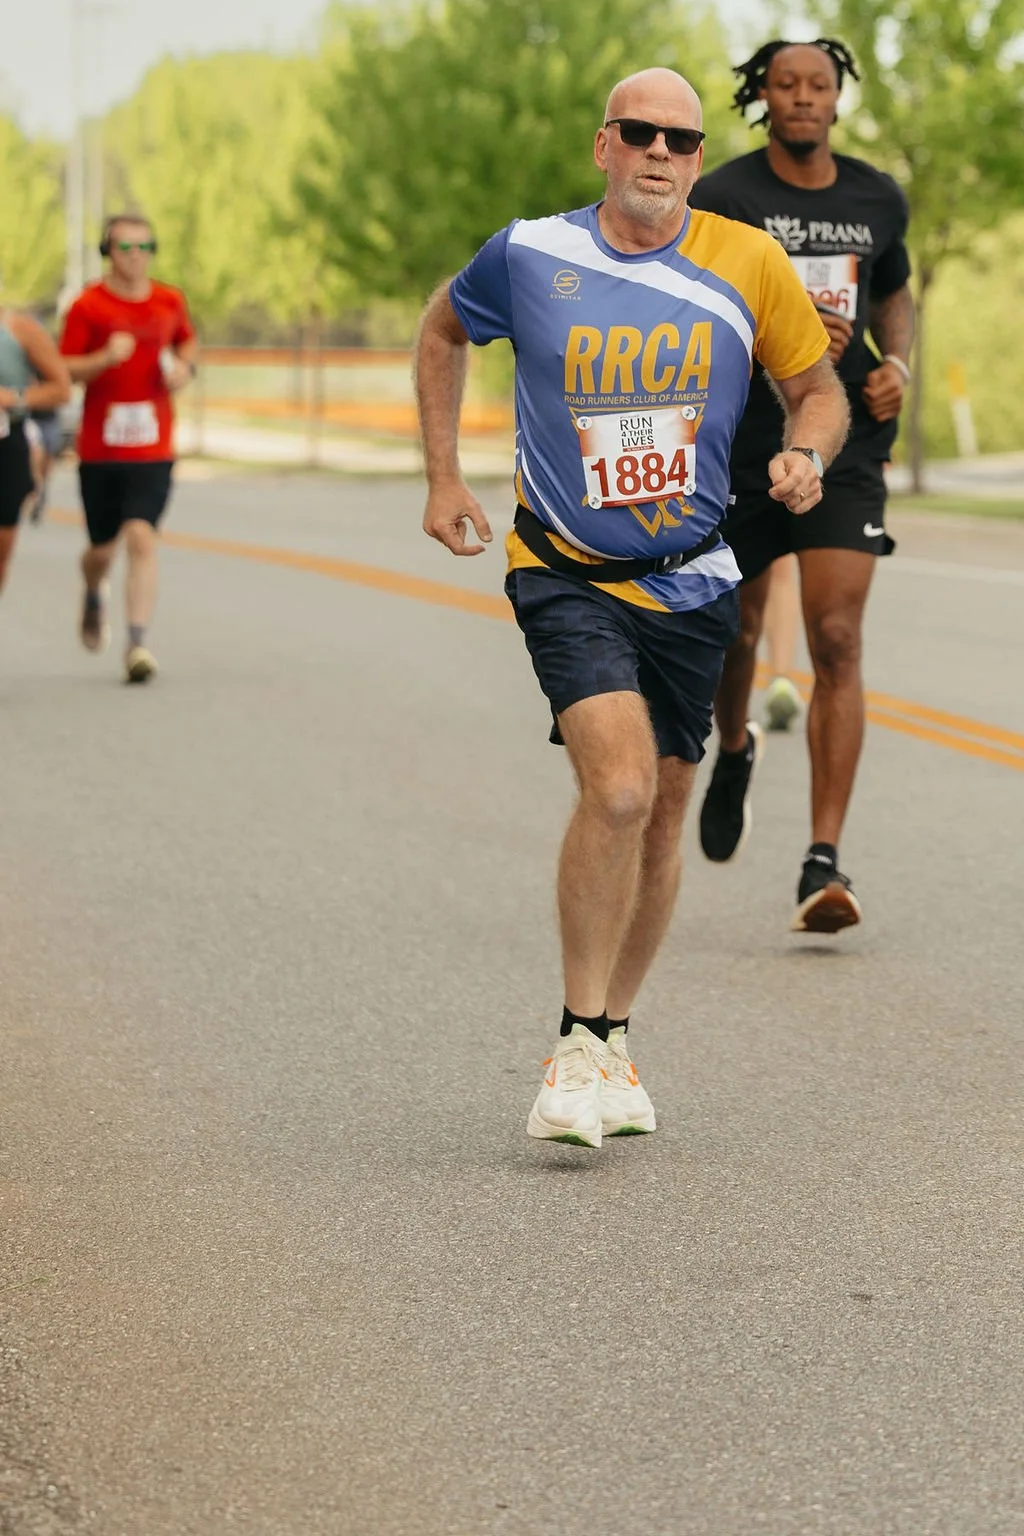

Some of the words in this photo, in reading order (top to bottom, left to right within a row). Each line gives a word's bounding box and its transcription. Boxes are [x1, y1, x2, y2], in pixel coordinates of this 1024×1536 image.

[808, 221, 873, 244] PRANA
[564, 321, 712, 394] RRCA
[564, 395, 586, 405] ROAD
[588, 396, 631, 405] RUNNERS
[633, 395, 657, 404] CLUB
[659, 394, 670, 403] OF
[672, 392, 708, 402] AMERICA
[620, 417, 652, 431] RUN
[629, 429, 653, 437] THEIR
[622, 436, 654, 447] LIVES
[591, 448, 689, 498] 1884
